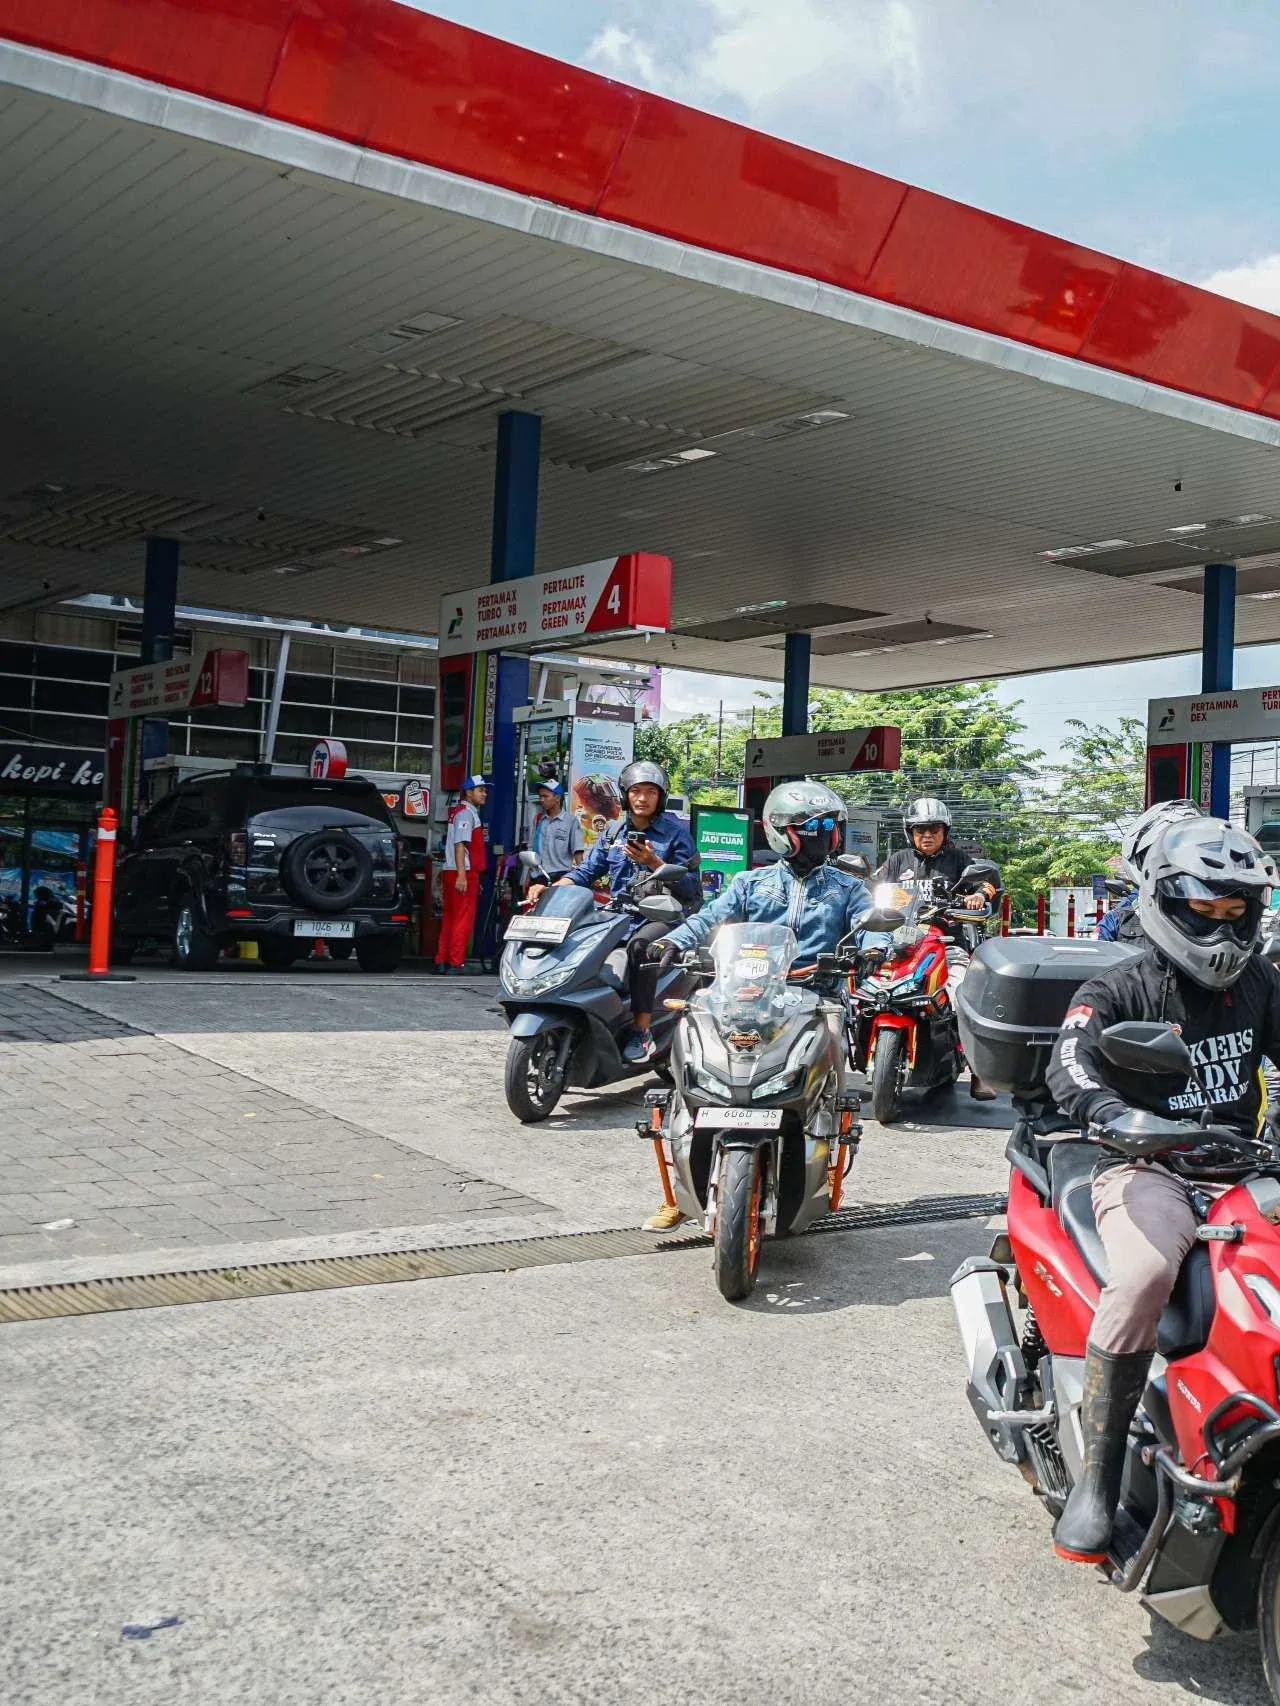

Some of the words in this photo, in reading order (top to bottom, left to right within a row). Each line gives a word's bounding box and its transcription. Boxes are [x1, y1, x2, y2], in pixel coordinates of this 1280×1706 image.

[543, 575, 585, 595] PERTALITE
[477, 589, 518, 608] PERTAMAX
[542, 595, 587, 615] PERTAMAX
[607, 584, 621, 615] 4
[477, 606, 502, 623] TURBO
[507, 604, 517, 617] 98
[541, 614, 569, 630] GREEN
[575, 612, 585, 625] 95
[476, 625, 516, 641] PERTAMAX
[517, 621, 528, 634] 92
[201, 671, 213, 695] 12
[1190, 699, 1239, 712] PERTAMINA
[1190, 712, 1208, 722] DEX
[864, 743, 878, 761] 10
[0, 753, 67, 783] kopi
[700, 834, 719, 844] JADI
[720, 836, 744, 846] CUAN
[1185, 1027, 1254, 1067] KERS
[1184, 1059, 1241, 1093] ADV
[701, 1110, 709, 1118] H
